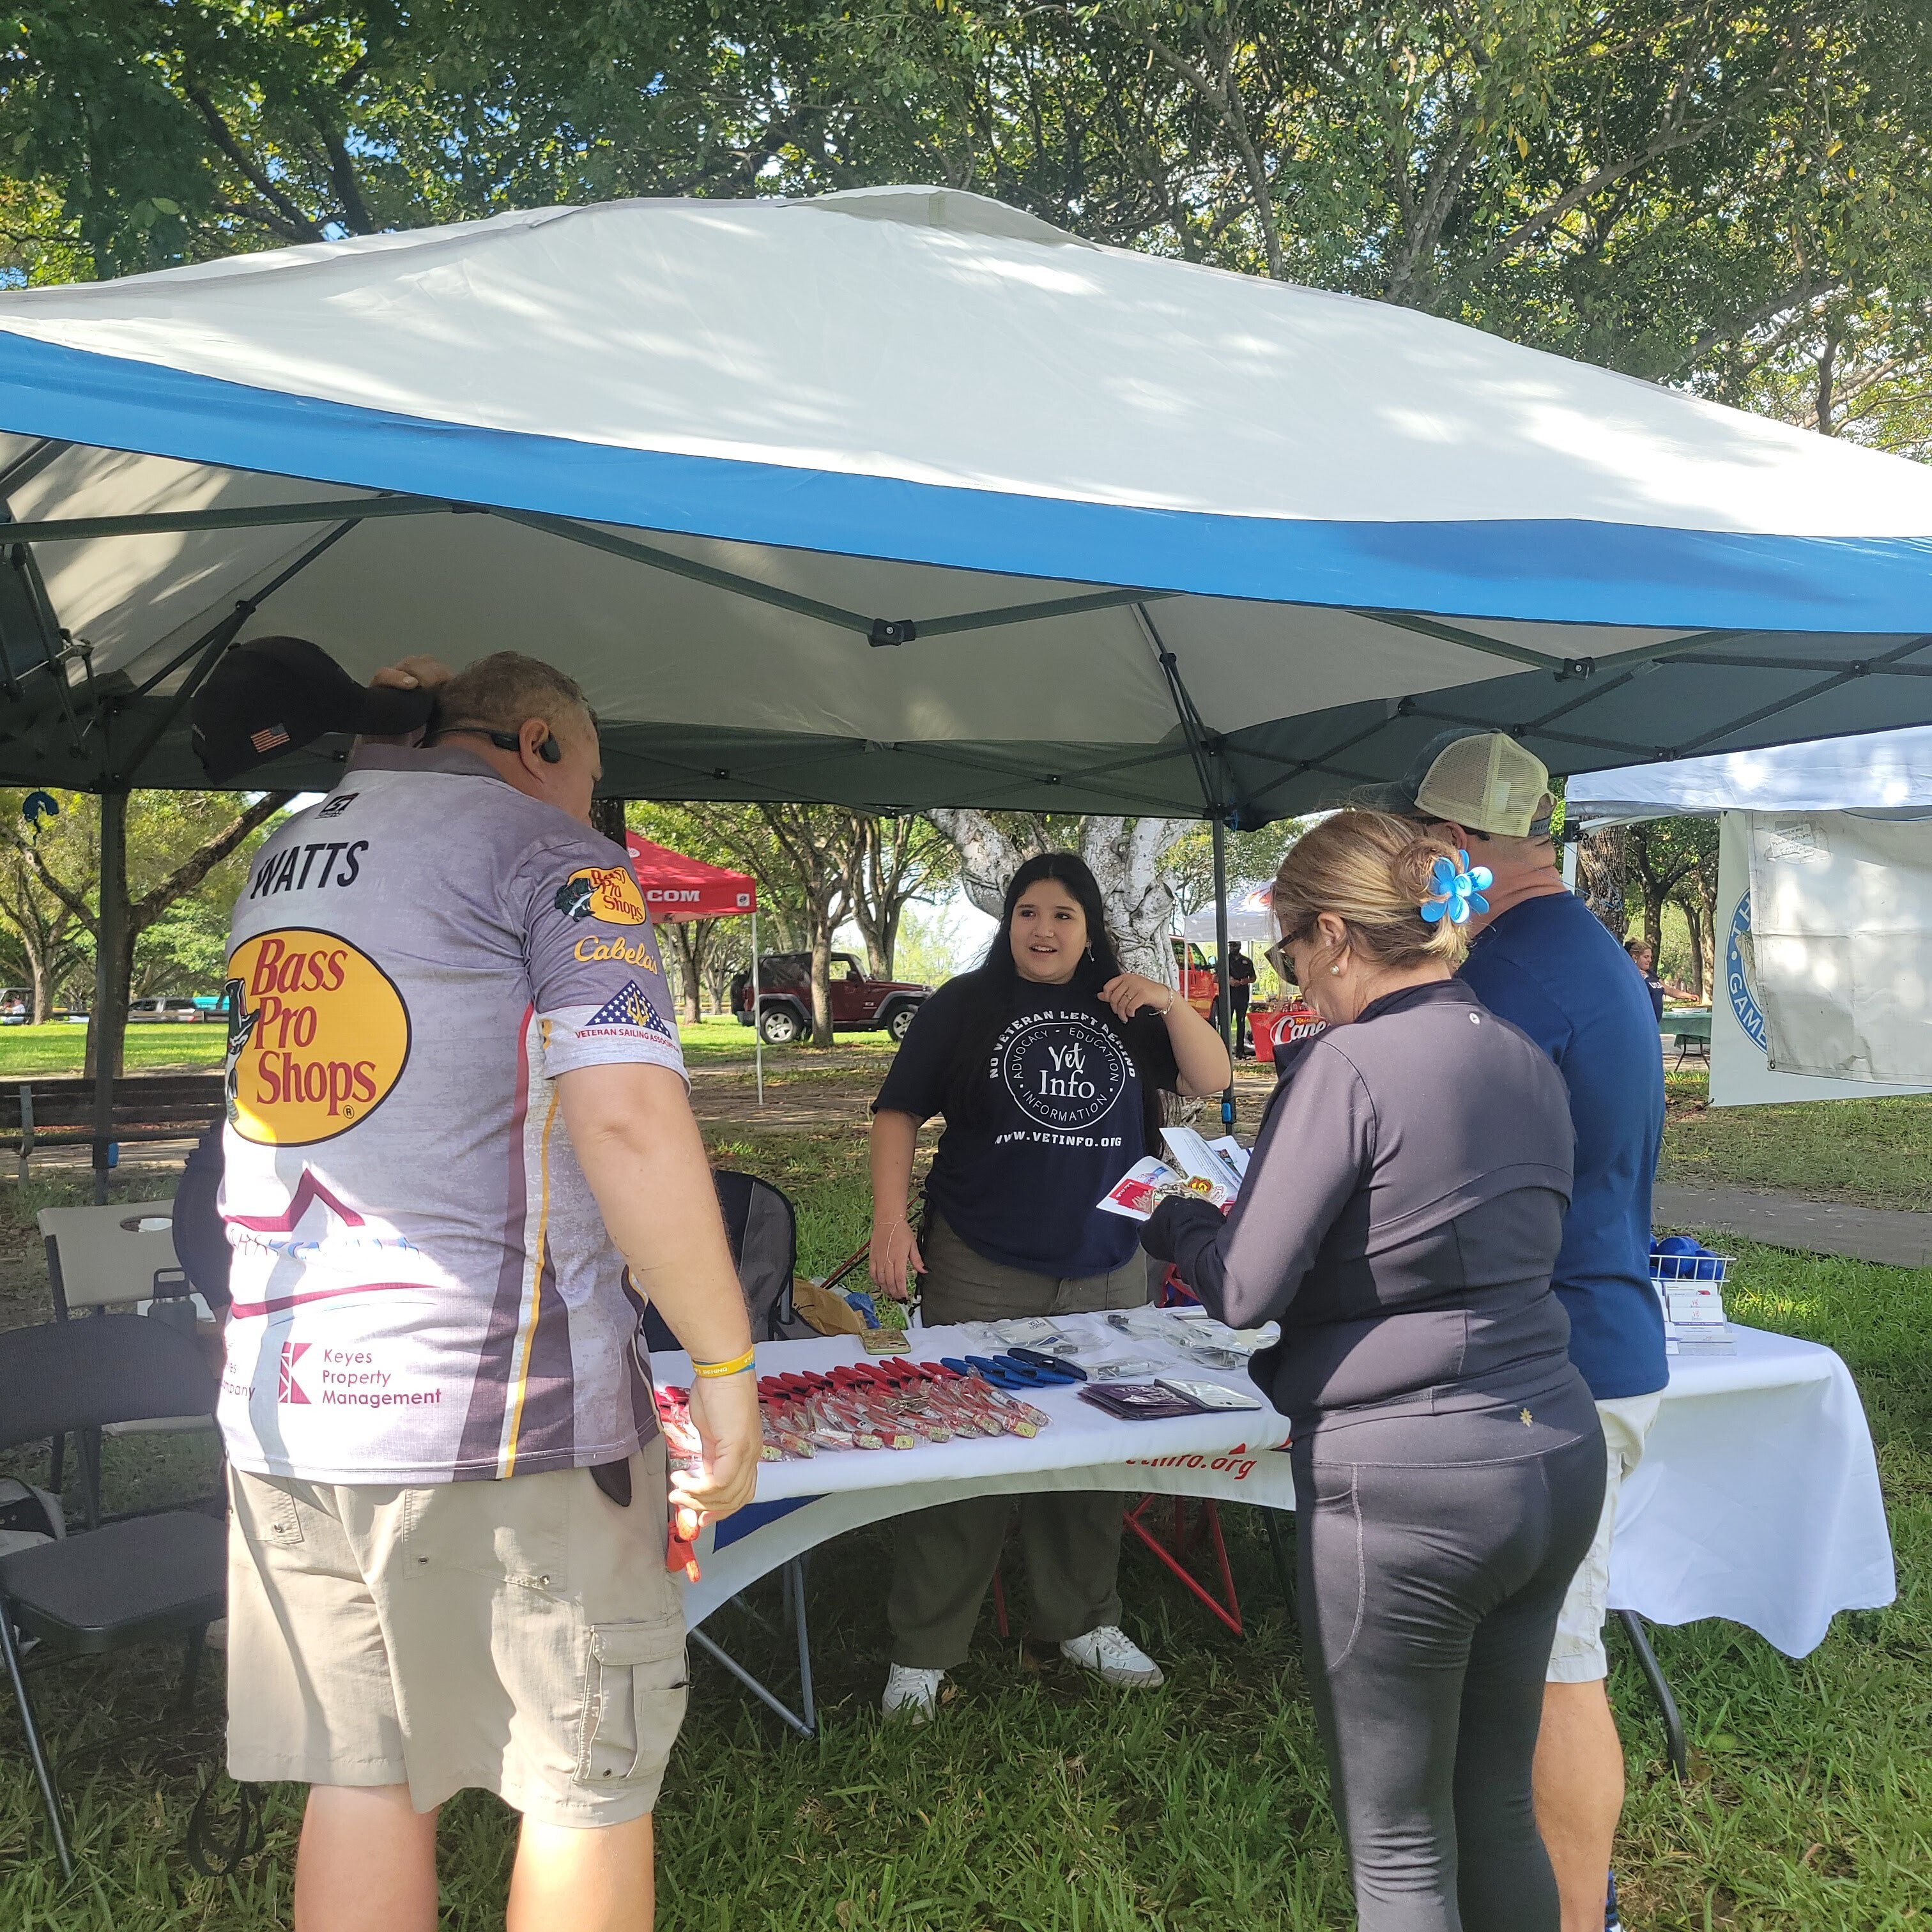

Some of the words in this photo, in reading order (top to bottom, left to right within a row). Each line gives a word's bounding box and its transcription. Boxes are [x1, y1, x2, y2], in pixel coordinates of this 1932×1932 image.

[250, 840, 369, 900] WATTS
[590, 870, 626, 885] Bass
[601, 878, 622, 898] Pro
[602, 895, 643, 920] Shops
[250, 938, 348, 996] Bass
[254, 996, 318, 1050] Pro
[992, 1010, 1054, 1051] VETERAN
[1060, 1011, 1098, 1026] LEFT
[574, 1029, 617, 1039] VETERAN
[618, 1028, 649, 1041] SAILING
[990, 1057, 999, 1079] NO
[1012, 1030, 1048, 1079] ADVOCACY
[1069, 1027, 1119, 1082] EDUCATION
[1048, 1042, 1085, 1071] Vet
[256, 1050, 377, 1116] Shops
[1038, 1070, 1095, 1099] Info
[1023, 1090, 1108, 1122] INFORMATION
[324, 1349, 372, 1367] Keyes
[323, 1370, 392, 1388] Property
[322, 1388, 442, 1408] Management
